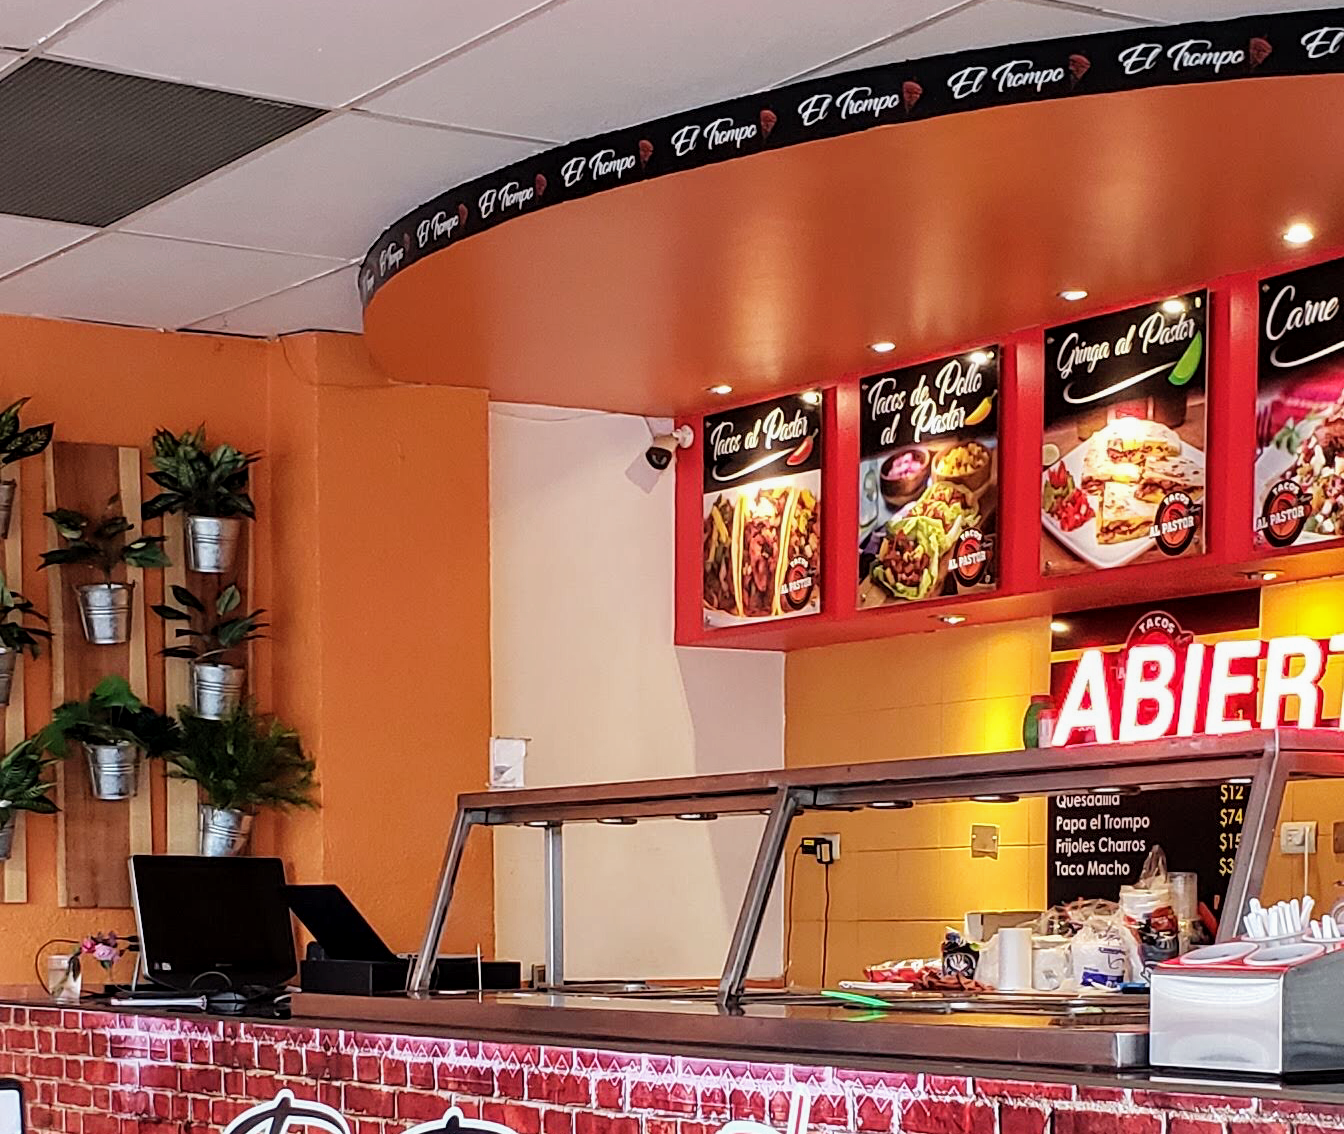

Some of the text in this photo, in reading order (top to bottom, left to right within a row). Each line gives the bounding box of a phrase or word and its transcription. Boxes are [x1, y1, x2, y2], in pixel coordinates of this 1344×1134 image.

[1118, 39, 1245, 75] El Trompo
[947, 59, 1065, 100] El Trompo
[798, 87, 900, 126] El Trompo
[671, 118, 757, 156] El Trompo
[561, 150, 636, 187] El Trompo
[479, 181, 534, 219] El Trompo
[1265, 285, 1340, 341] Carne
[1057, 311, 1196, 379] Gringa al Pastor
[868, 359, 982, 421] Tacos de Pollo
[710, 407, 808, 461] Tacos al Pastor
[880, 398, 966, 445] al Pastor
[1269, 505, 1305, 526] PASTOR
[1138, 616, 1175, 634] TACOS
[1056, 814, 1151, 834] Papa el Trompo
[1056, 837, 1146, 857] Frijoles Charros
[1055, 860, 1130, 876] Taco Macho
